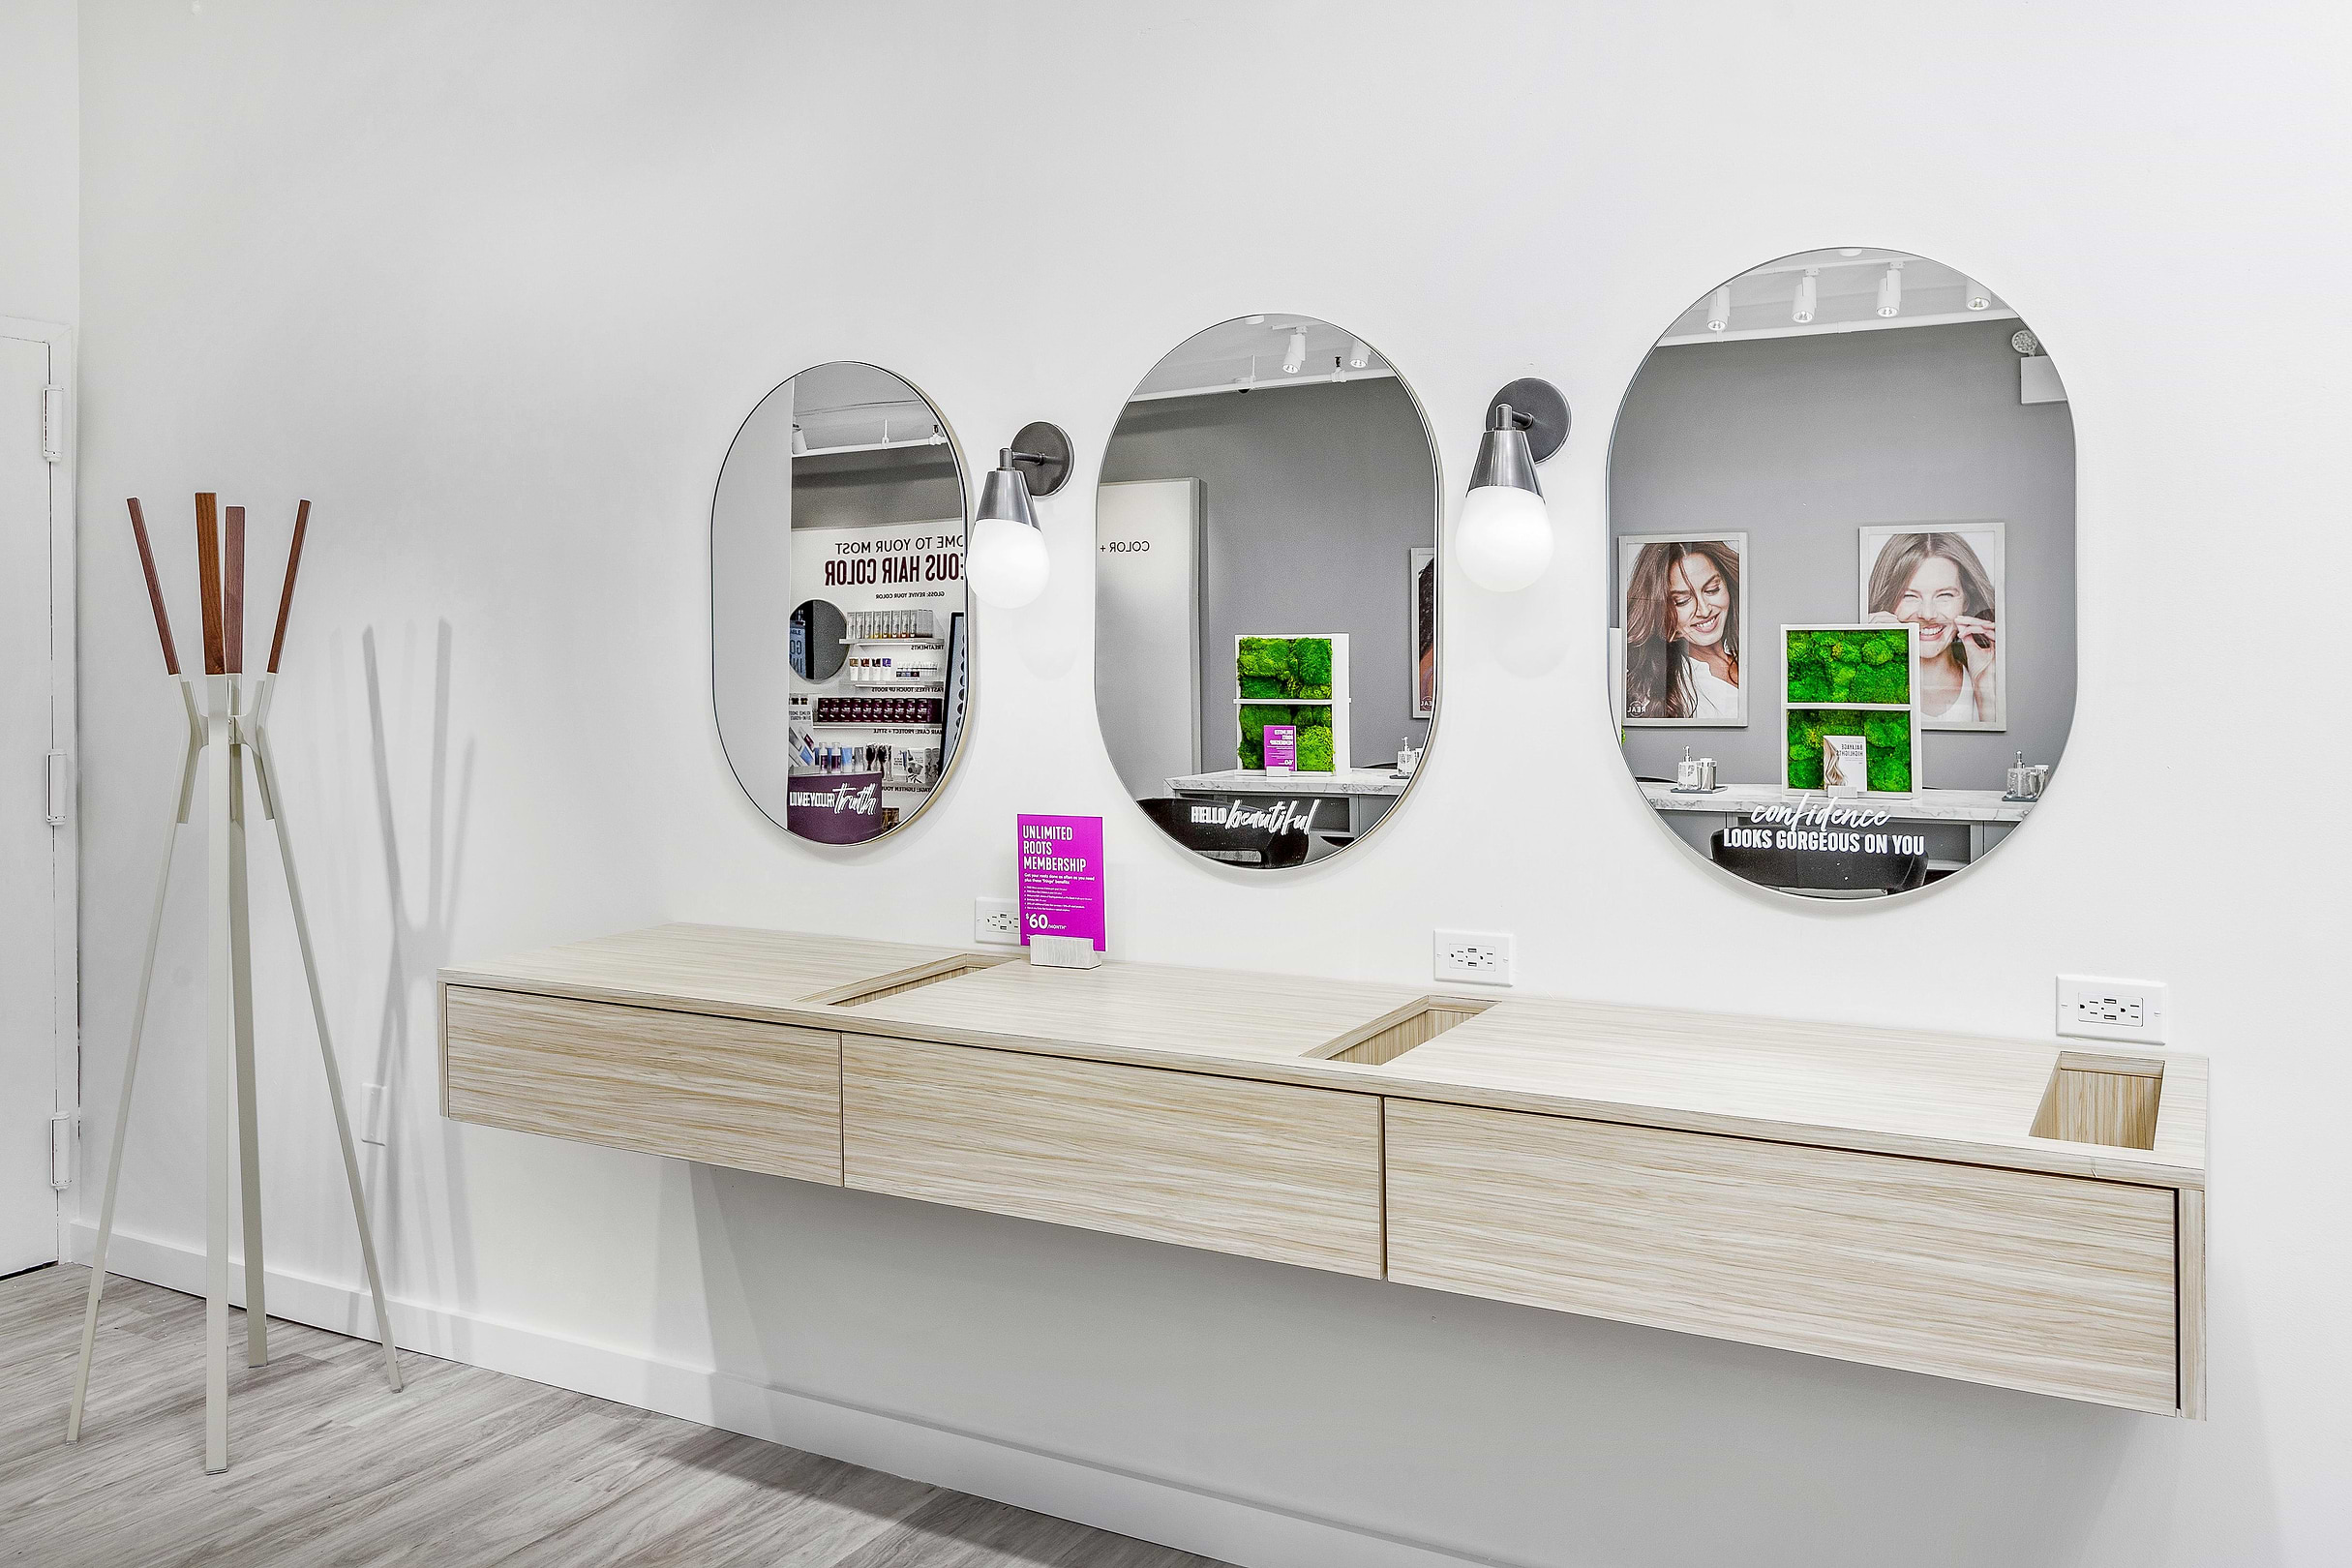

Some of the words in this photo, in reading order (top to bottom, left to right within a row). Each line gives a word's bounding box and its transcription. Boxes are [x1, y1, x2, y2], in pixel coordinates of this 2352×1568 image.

[1191, 805, 1227, 825] HELLO
[1224, 799, 1320, 836] beautiful
[1750, 792, 1891, 832] confidence
[1022, 824, 1073, 841] UNLIMITED
[1723, 828, 1772, 849] LOOKS
[1776, 830, 1860, 853] GORGEOUS
[1864, 833, 1887, 855] ON
[1891, 833, 1925, 856] YOU
[1023, 840, 1053, 856] ROOTS
[1023, 856, 1087, 873] MEMBERSHIP
